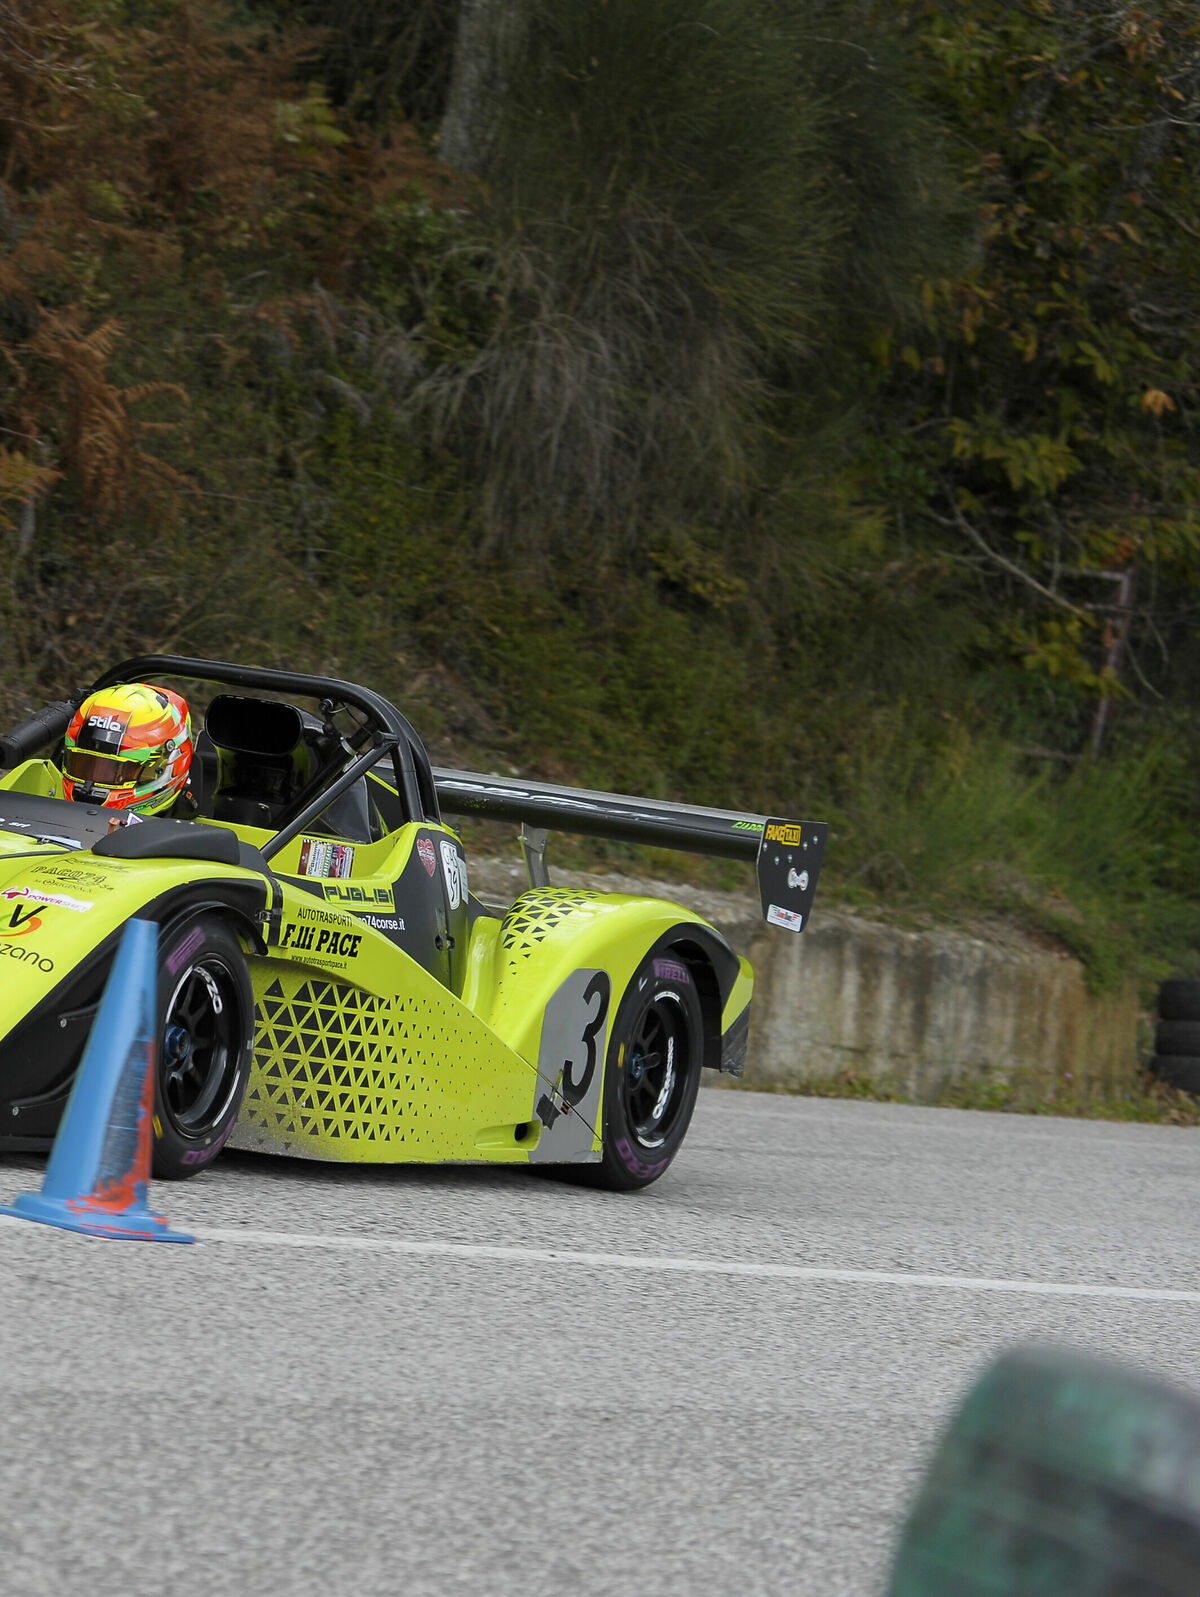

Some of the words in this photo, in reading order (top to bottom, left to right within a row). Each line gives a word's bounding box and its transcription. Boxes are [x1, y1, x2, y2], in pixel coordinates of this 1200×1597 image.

[88, 715, 122, 733] stilo
[765, 824, 785, 841] FAKE
[785, 828, 800, 843] TAXI
[324, 885, 394, 905] PUGLISI
[297, 906, 353, 927] AUTOTRASPORTI
[357, 914, 406, 931] o74corse.it
[315, 929, 362, 958] PACE
[653, 958, 690, 985] PIRELLI
[562, 969, 612, 1107] 3
